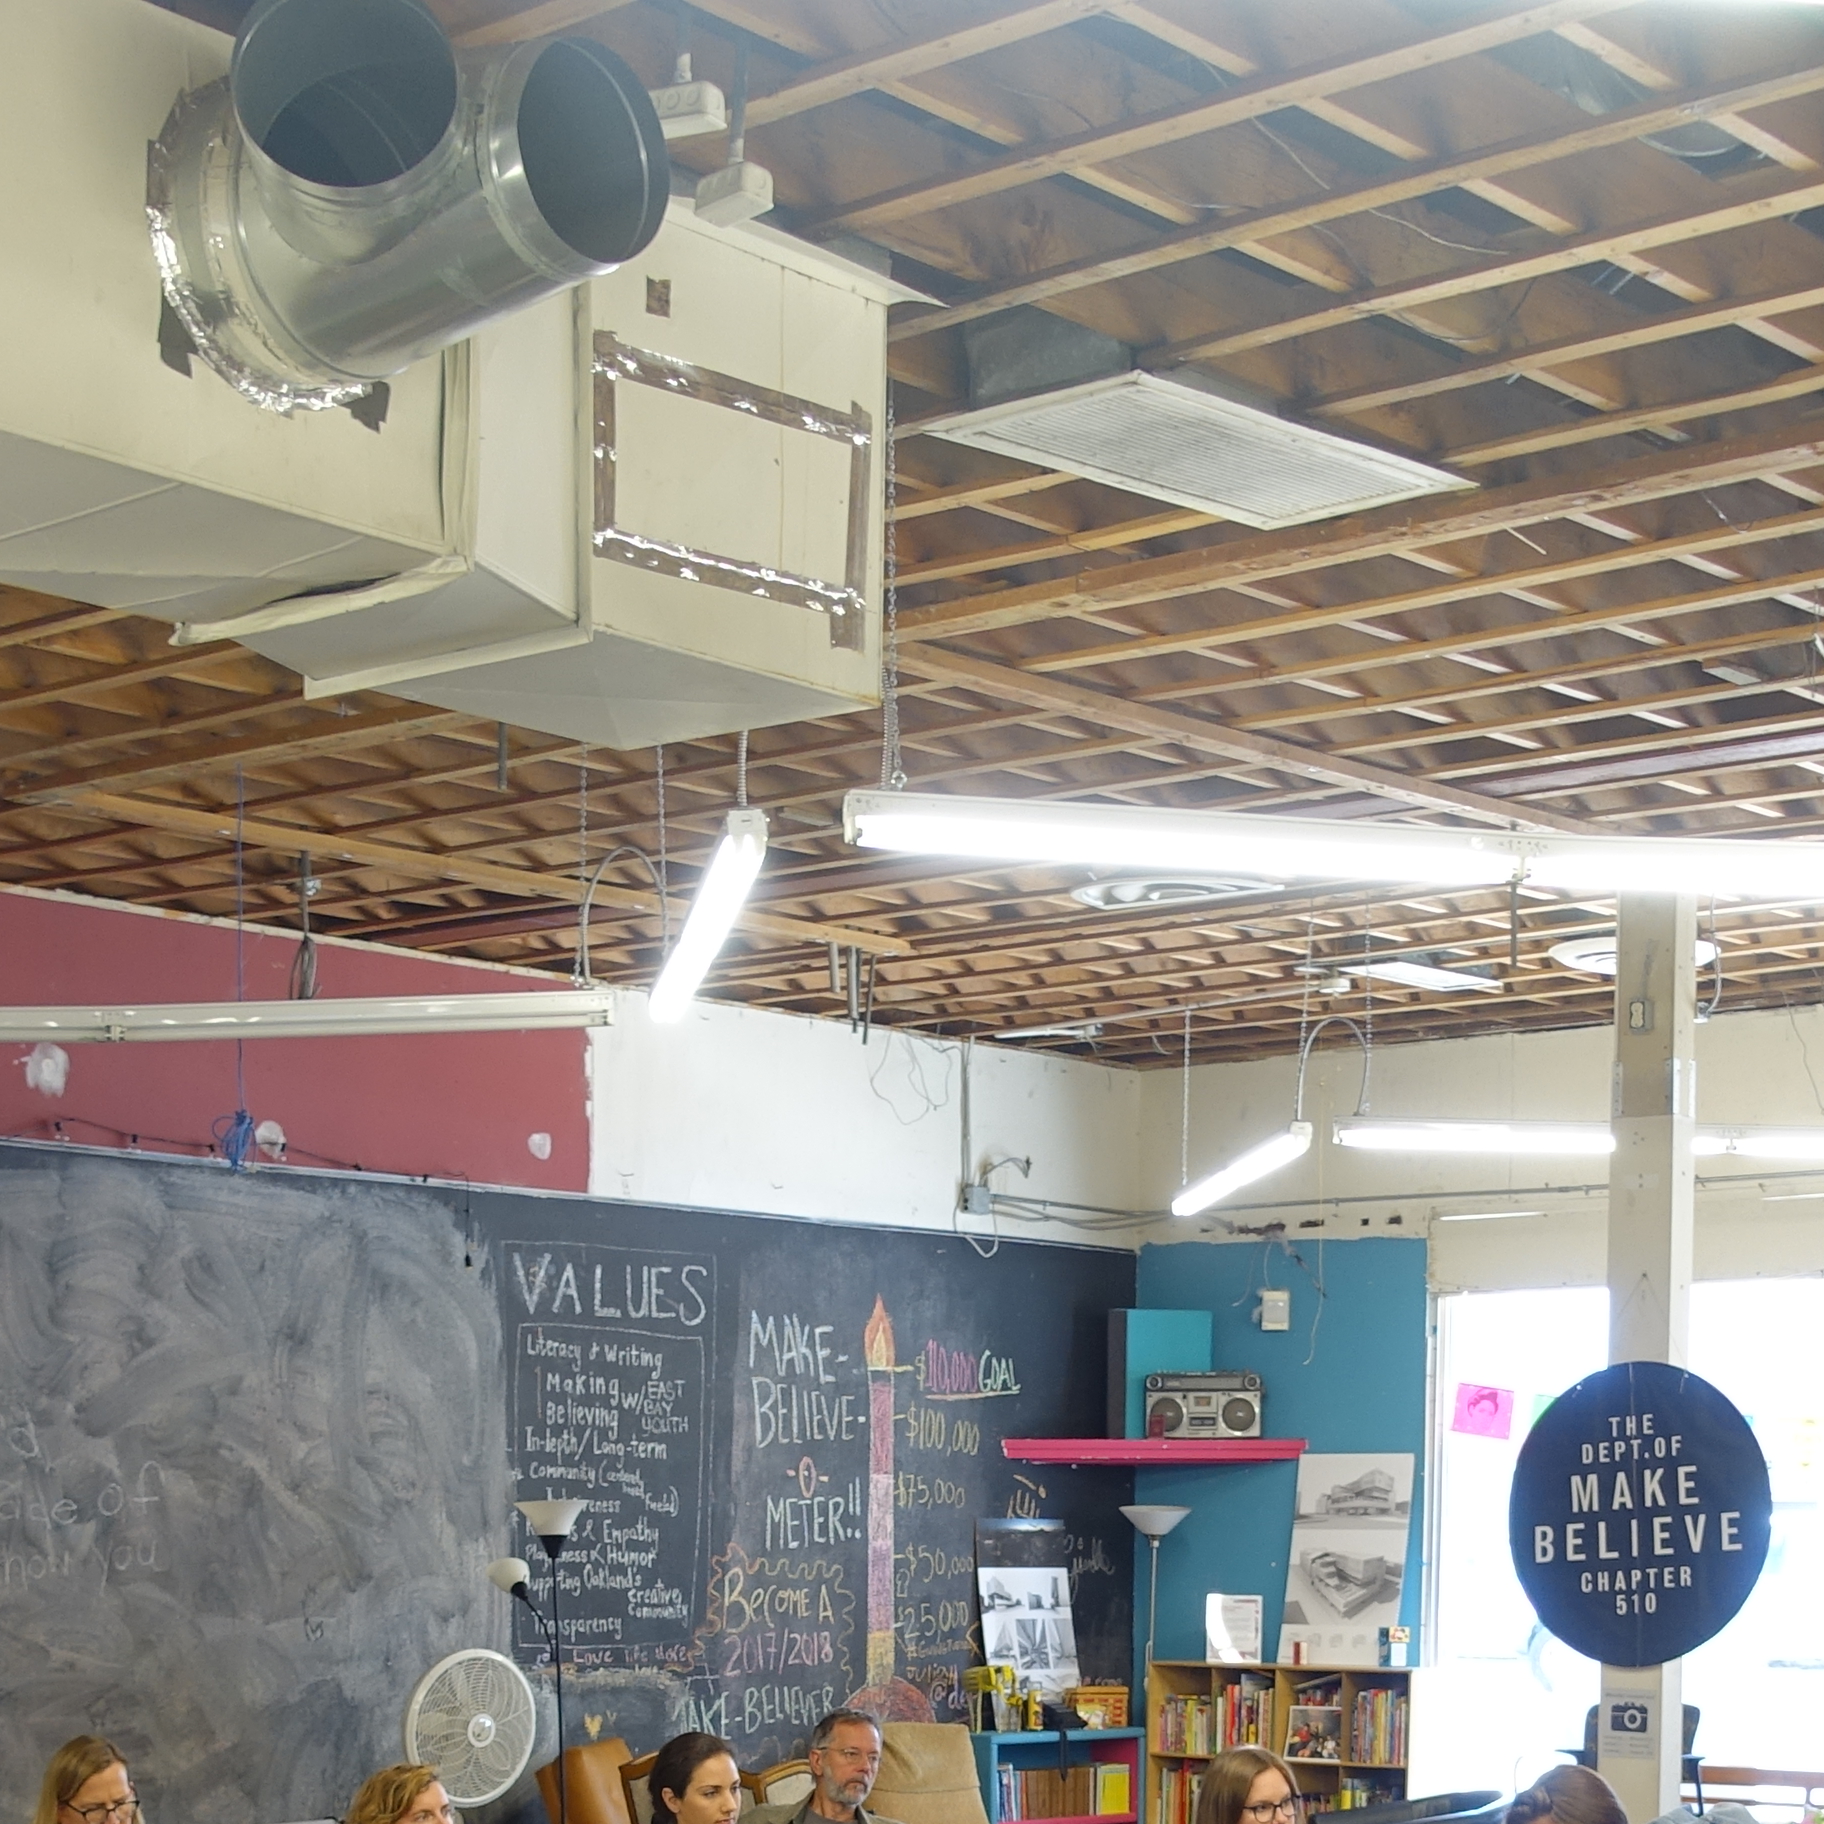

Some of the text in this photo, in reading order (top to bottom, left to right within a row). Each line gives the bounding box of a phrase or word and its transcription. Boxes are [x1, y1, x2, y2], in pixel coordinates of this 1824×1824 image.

[513, 1252, 707, 1326] VALUES
[527, 1334, 581, 1372] Literacy
[604, 1344, 663, 1379] Writing
[749, 1310, 849, 1384] MAKE-
[546, 1372, 619, 1406] Making
[647, 1380, 685, 1400] EAST
[978, 1350, 1021, 1392] GOAL
[546, 1400, 618, 1440] Believing
[905, 1401, 980, 1457] $100,000
[1608, 1413, 1655, 1437] THE
[1581, 1435, 1683, 1464] DEPT. OF
[97, 1460, 168, 1516] of
[529, 1462, 596, 1488] Community
[893, 1471, 966, 1509] $75,000
[1570, 1465, 1700, 1514] MAKE
[603, 1516, 659, 1552] Empathy
[1534, 1511, 1743, 1564] BELIEVE
[96, 1540, 168, 1596] you
[606, 1545, 658, 1568] Humor
[905, 1542, 973, 1583] $50,000
[583, 1564, 642, 1592] Oakland's
[1581, 1566, 1692, 1593] CHAPTER
[819, 1584, 835, 1625] A
[894, 1600, 970, 1645] $25,000
[1616, 1592, 1658, 1615] 510
[533, 1609, 622, 1643] Transparency
[723, 1627, 834, 1677] 2017/2018
